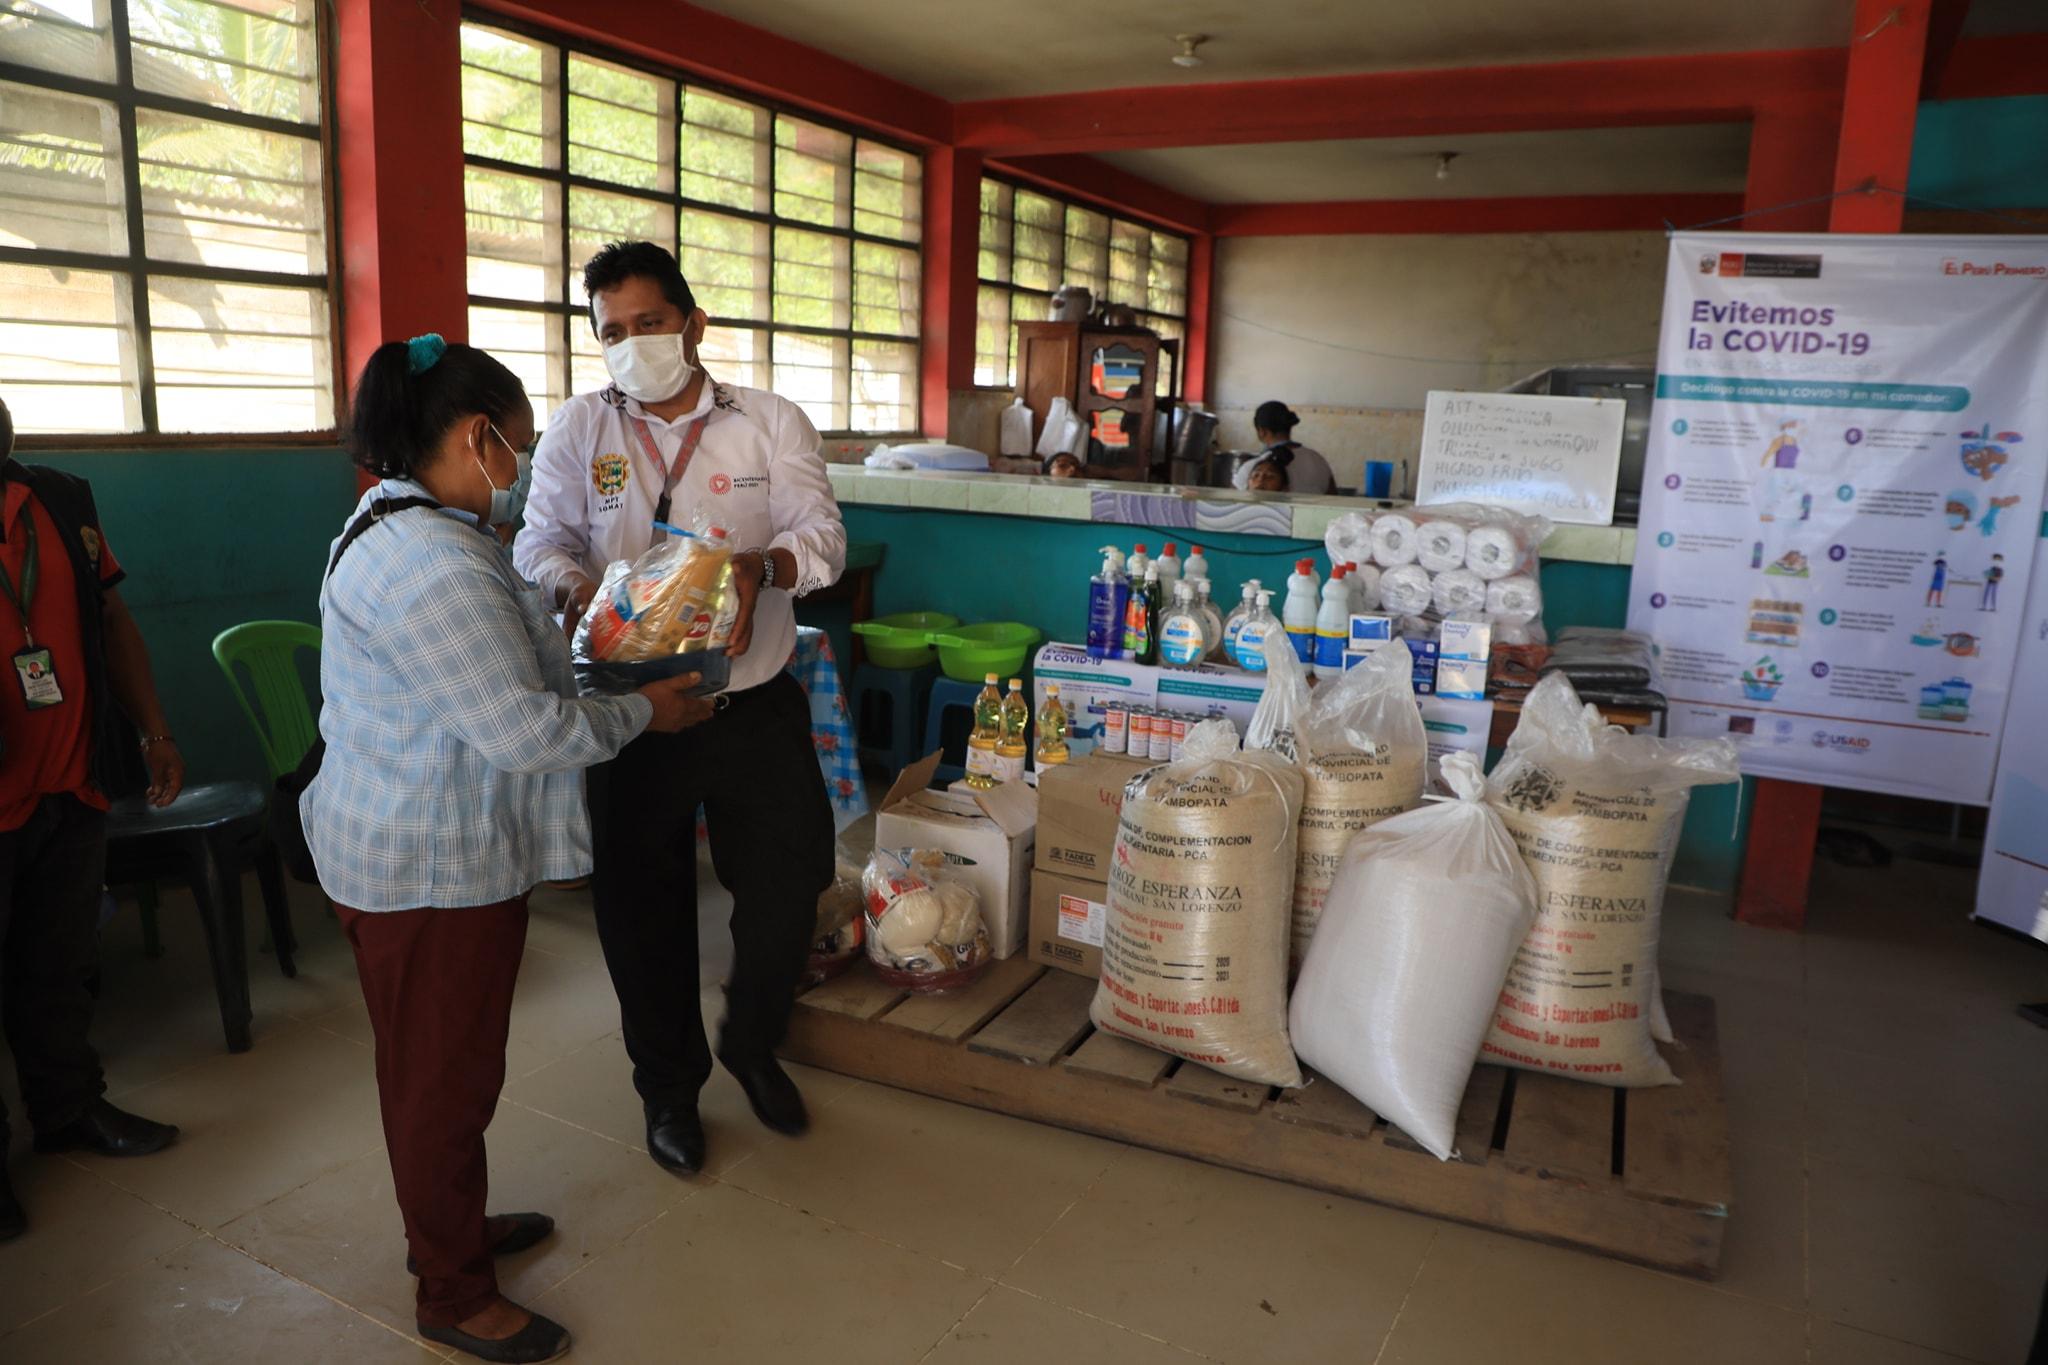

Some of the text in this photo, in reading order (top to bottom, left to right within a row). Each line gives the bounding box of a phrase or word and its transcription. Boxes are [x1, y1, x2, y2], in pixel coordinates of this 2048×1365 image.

[1691, 300, 1835, 327] Evitemos
[1687, 327, 1870, 356] la COVID-19
[1737, 386, 1775, 397] contra
[1344, 821, 1367, 831] PCA
[1145, 831, 1252, 847] COMPLEMENTACION
[1537, 838, 1552, 850] DE
[1184, 849, 1208, 860] PCA
[1600, 861, 1624, 873] PCA
[1142, 878, 1243, 901] ESPERANZA
[1152, 898, 1177, 913] SAN
[1181, 901, 1243, 914] LORENZO
[1548, 891, 1647, 913] ESPERANZA
[1560, 910, 1588, 922] SAN
[1481, 1041, 1544, 1067] OHIBIDA
